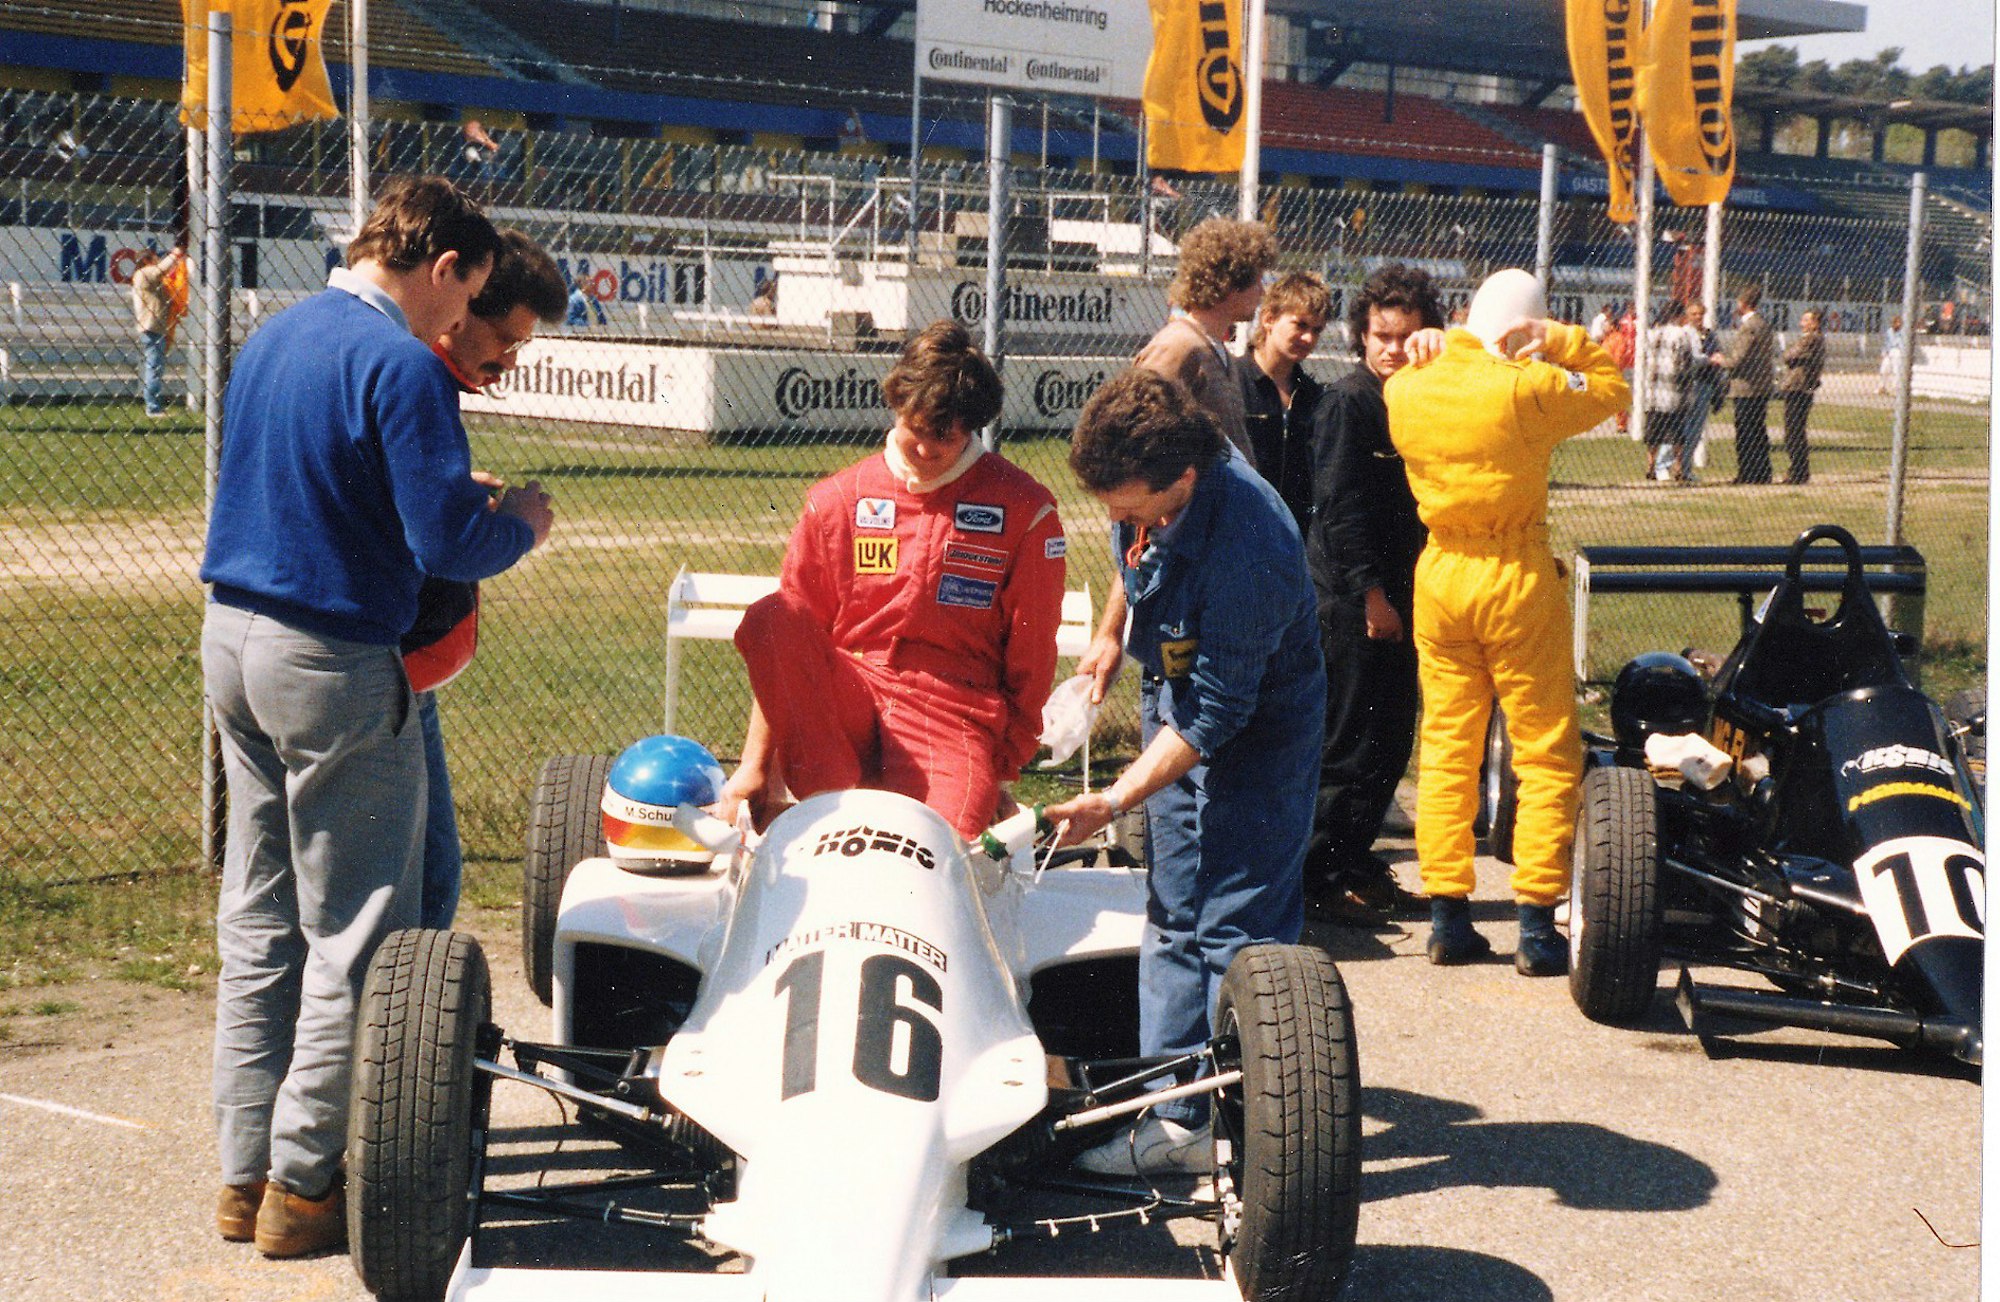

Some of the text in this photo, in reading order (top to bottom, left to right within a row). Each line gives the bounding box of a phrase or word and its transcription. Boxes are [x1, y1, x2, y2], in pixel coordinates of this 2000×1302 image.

[984, 0, 1108, 30] Hockenheimring
[928, 47, 1009, 73] Continental
[1025, 57, 1101, 83] Continental
[951, 281, 1112, 326] Cotinental
[963, 511, 993, 523] Ford
[1871, 851, 1985, 940] 10
[856, 921, 947, 973] MATTER
[773, 949, 943, 1103] 16
